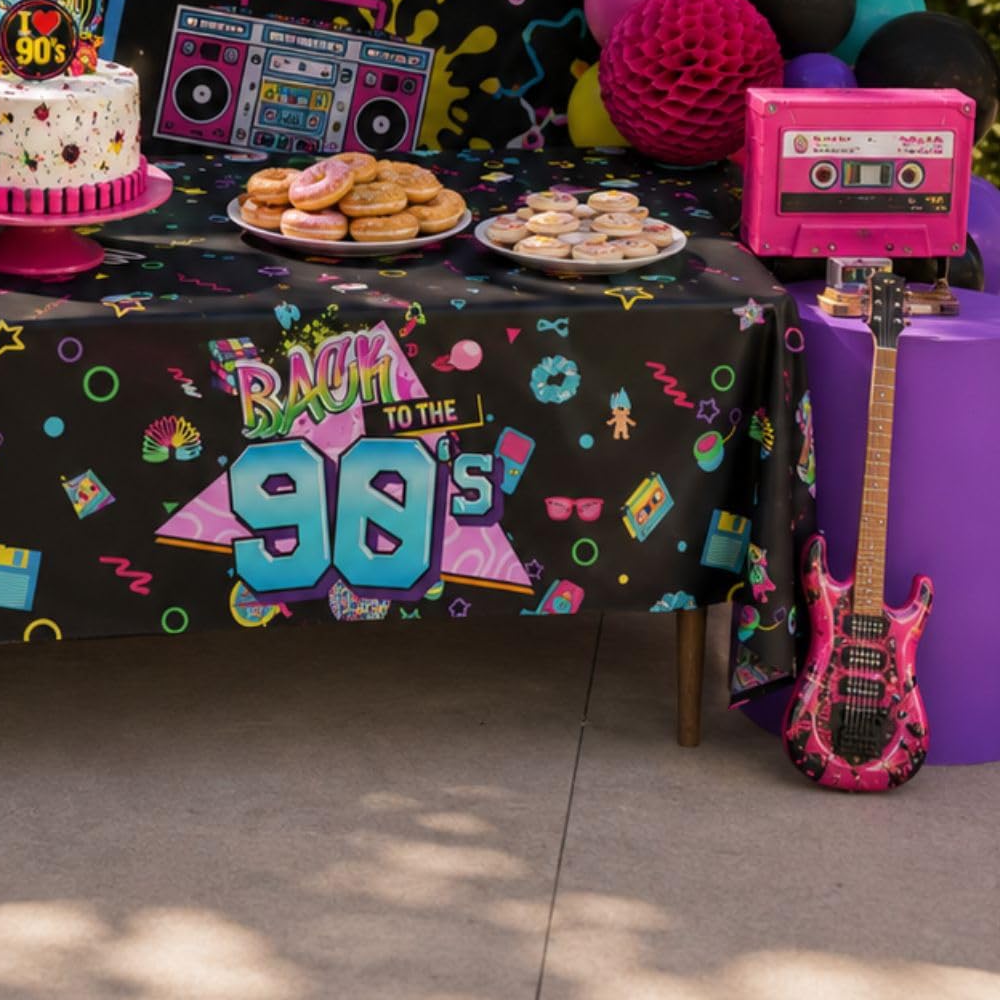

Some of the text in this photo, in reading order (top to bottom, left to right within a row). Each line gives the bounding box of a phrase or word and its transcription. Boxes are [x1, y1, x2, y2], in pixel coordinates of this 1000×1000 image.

[18, 10, 32, 35] I
[15, 36, 66, 65] 90's
[383, 406, 411, 430] TO
[415, 399, 456, 426] THE
